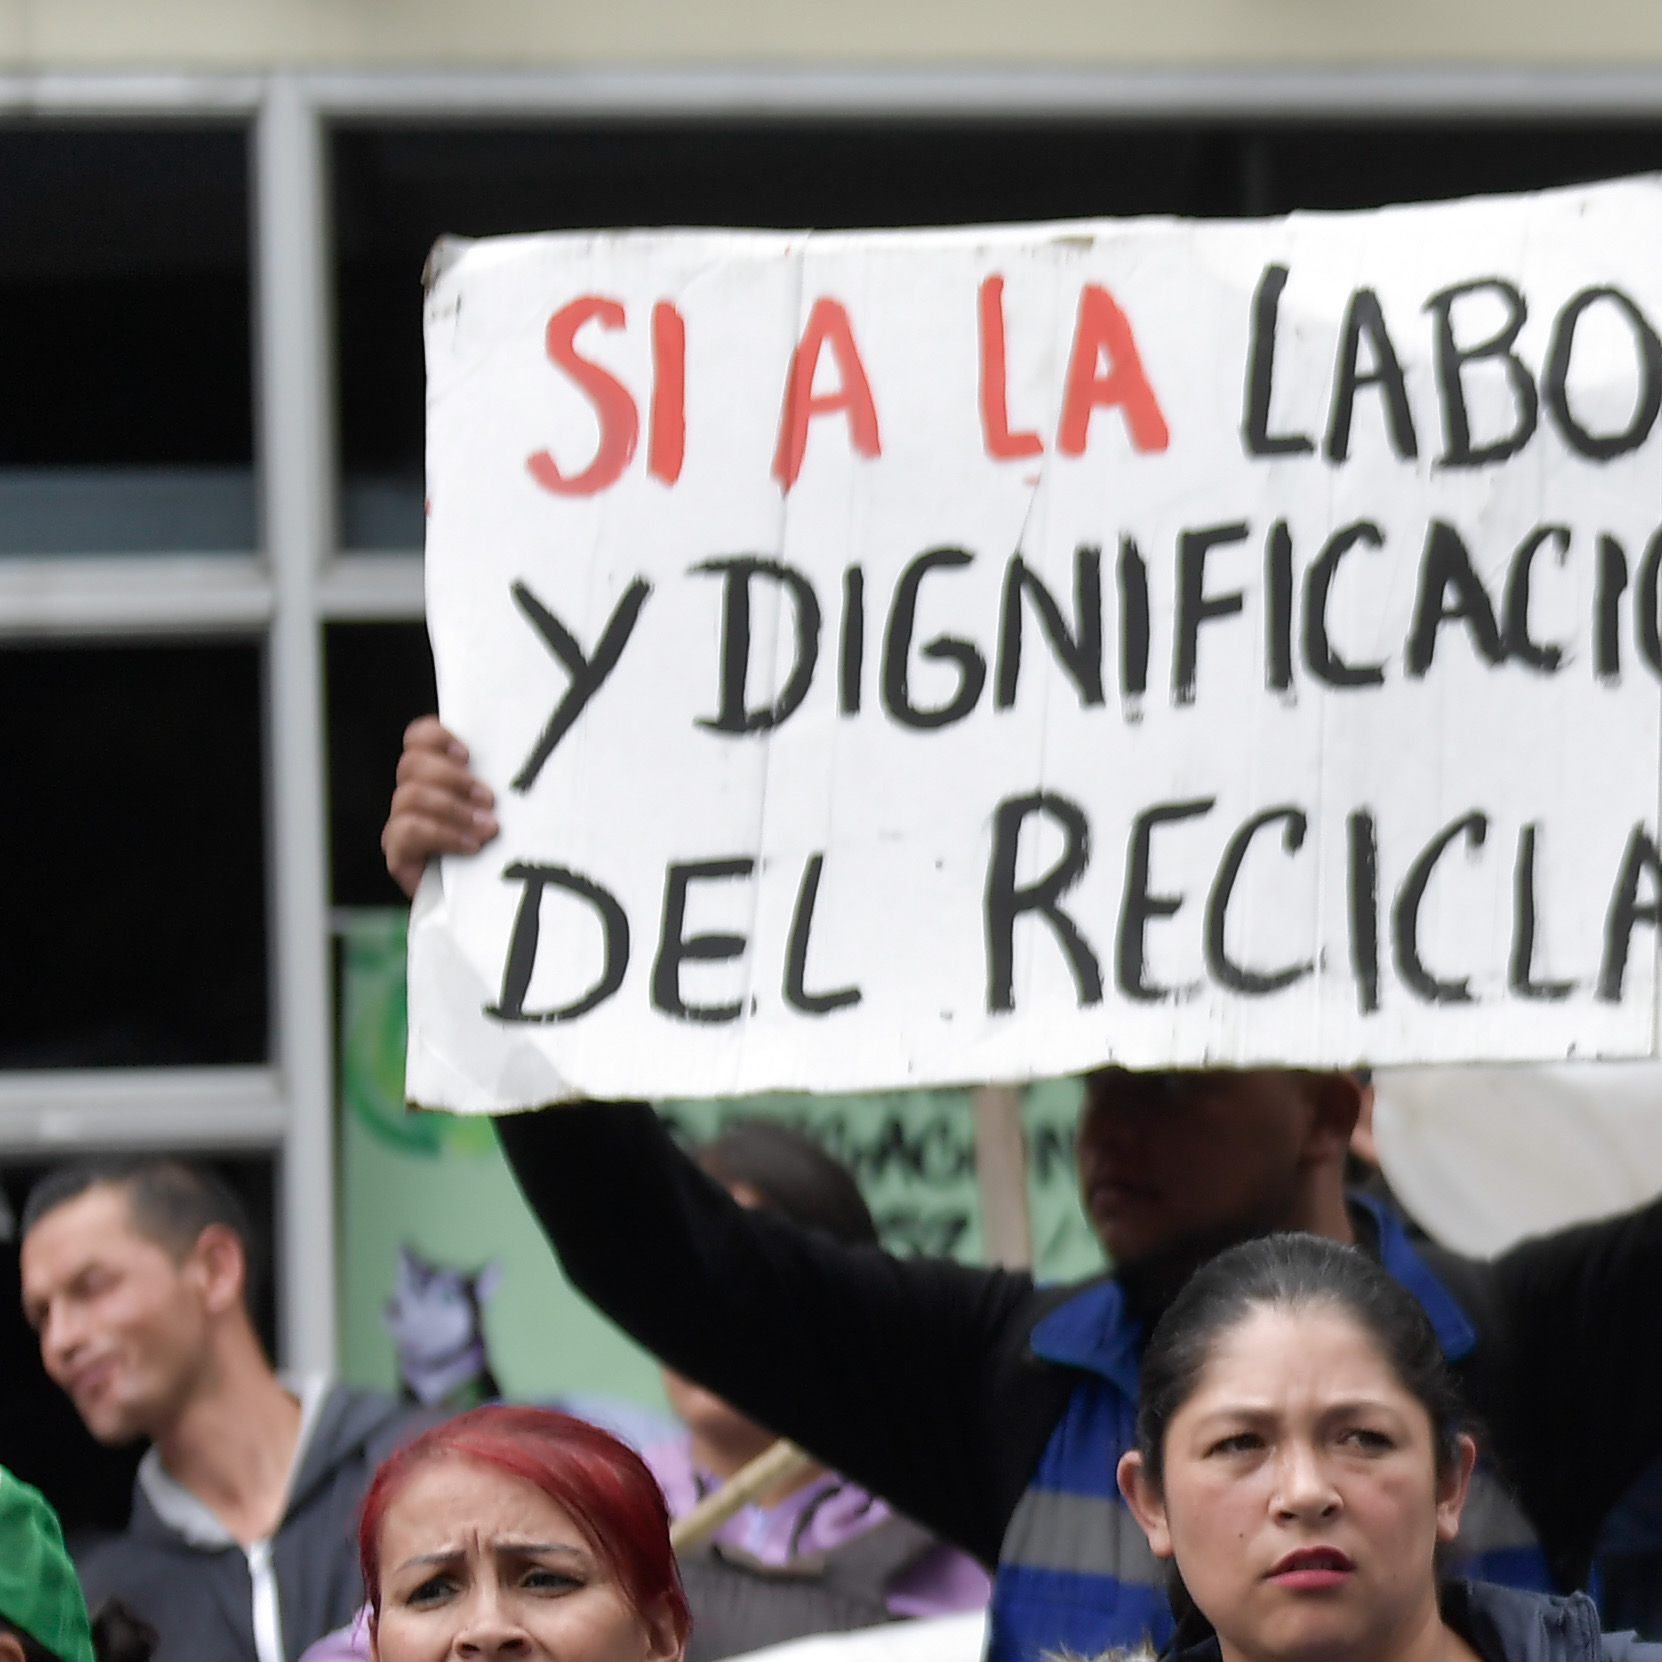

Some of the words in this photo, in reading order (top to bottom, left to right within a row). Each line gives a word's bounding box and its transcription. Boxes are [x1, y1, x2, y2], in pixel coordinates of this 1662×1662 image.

[527, 291, 688, 496] SI
[770, 296, 884, 496] A
[975, 271, 1172, 461] LA
[507, 574, 652, 794] Y
[481, 851, 864, 1027] DEL
